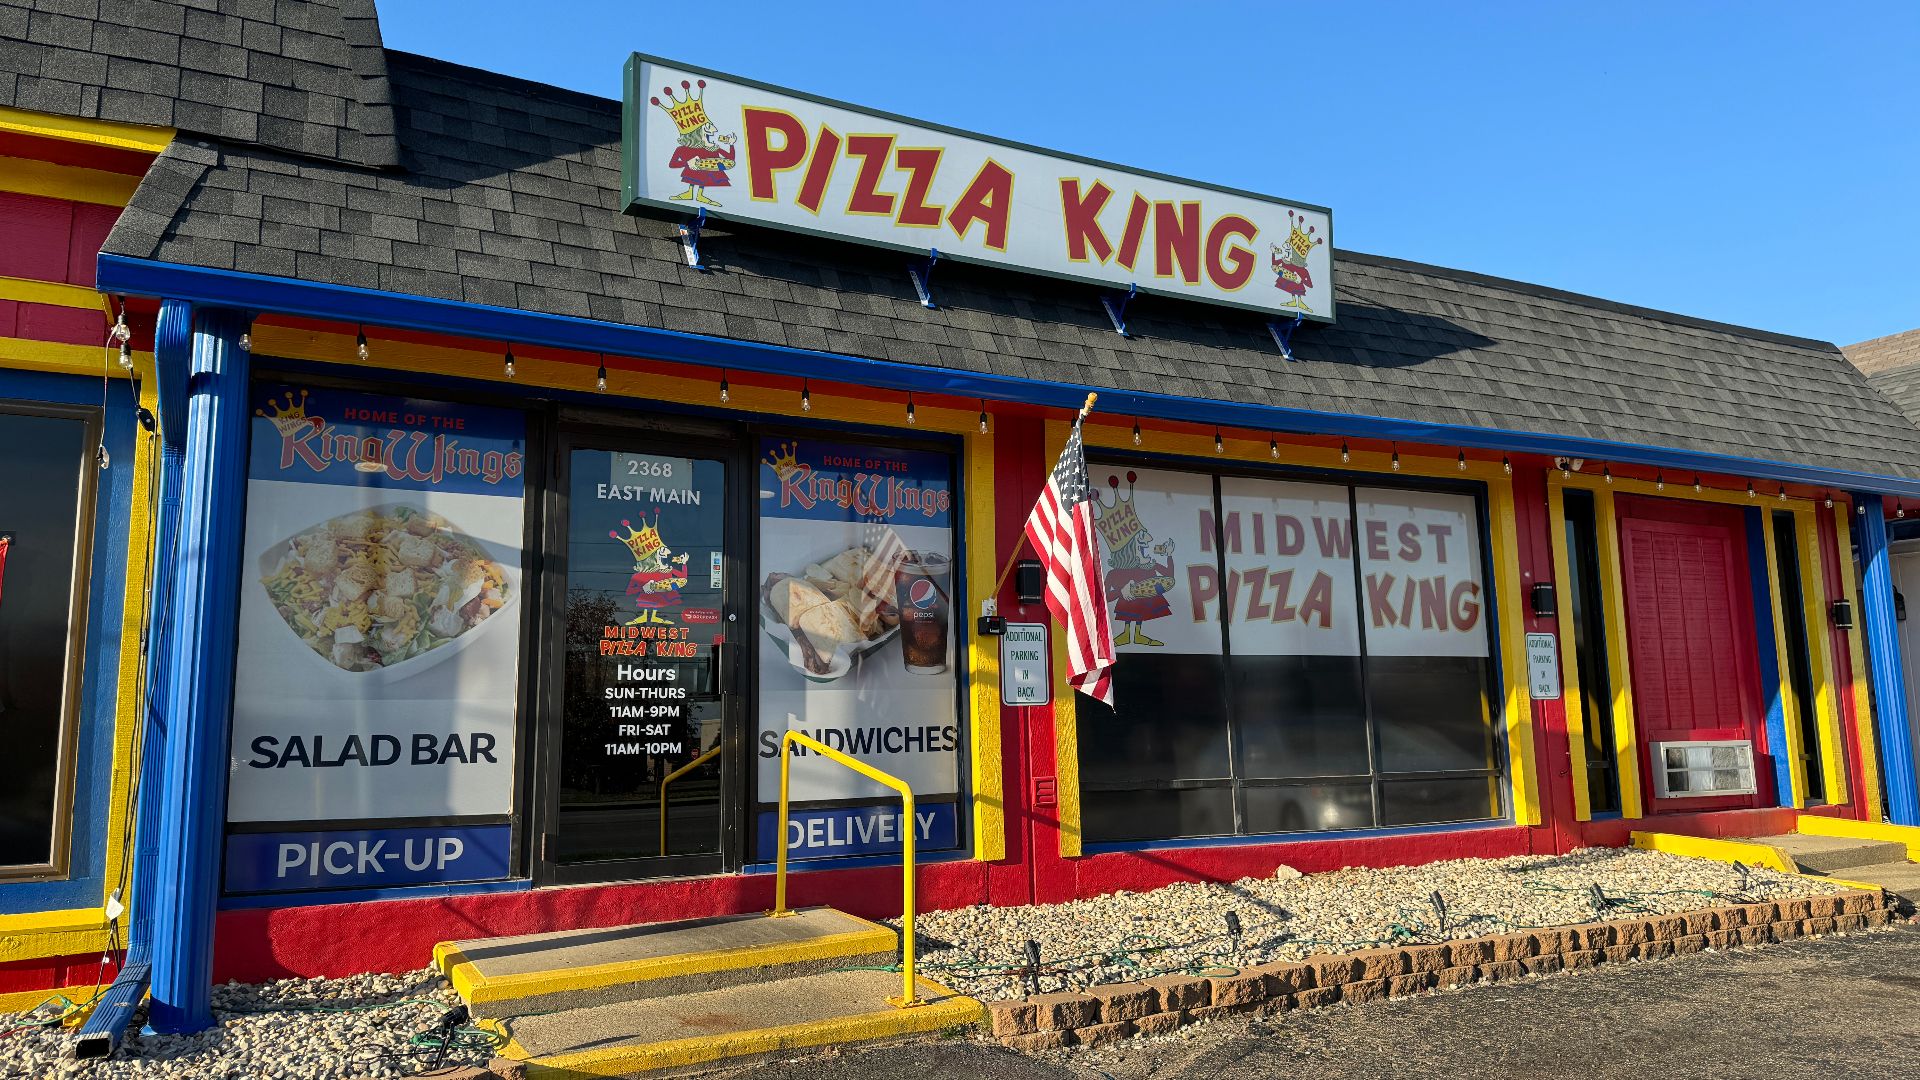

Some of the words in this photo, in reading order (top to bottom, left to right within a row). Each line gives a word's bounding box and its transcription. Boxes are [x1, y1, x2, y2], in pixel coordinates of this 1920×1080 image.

[670, 103, 702, 120] PIZZA
[676, 113, 706, 130] KING
[741, 104, 1015, 252] PIZZA
[1058, 176, 1260, 291] KING
[1289, 237, 1306, 256] KING
[1292, 229, 1310, 251] PIZZA
[344, 408, 398, 424] HOME
[404, 413, 426, 427] OF
[433, 416, 465, 430] THE
[627, 460, 673, 478] 2368
[823, 455, 861, 469] HOME
[865, 458, 881, 471] OF
[884, 460, 908, 472] THE
[597, 483, 643, 502] EAST
[650, 487, 700, 505] MAIN
[1099, 504, 1134, 534] PIZZA
[627, 528, 657, 549] PIZZA
[1106, 518, 1139, 546] KING
[1199, 509, 1453, 564] MIDWEST
[634, 538, 661, 558] KING
[1185, 562, 1334, 629] PIZZA
[1365, 571, 1480, 632] KING
[604, 626, 690, 640] MIDWEST
[1005, 631, 1043, 642] ADDITIONAL
[600, 639, 647, 656] PIZZA
[656, 640, 698, 657] KING
[1010, 650, 1039, 661] PARKING
[617, 664, 676, 681] Hours
[1022, 669, 1029, 680] IN
[605, 687, 686, 700] SUN-THURS
[1017, 687, 1035, 698] BACK
[609, 705, 680, 718] 11AM-9PM
[618, 723, 672, 736] FRI-SAT
[248, 733, 402, 769] SALAD
[410, 732, 498, 766] BAR
[605, 742, 682, 755] 11AM-10PM
[759, 725, 959, 759] SANDWICHES
[277, 837, 464, 878] PICK-UP
